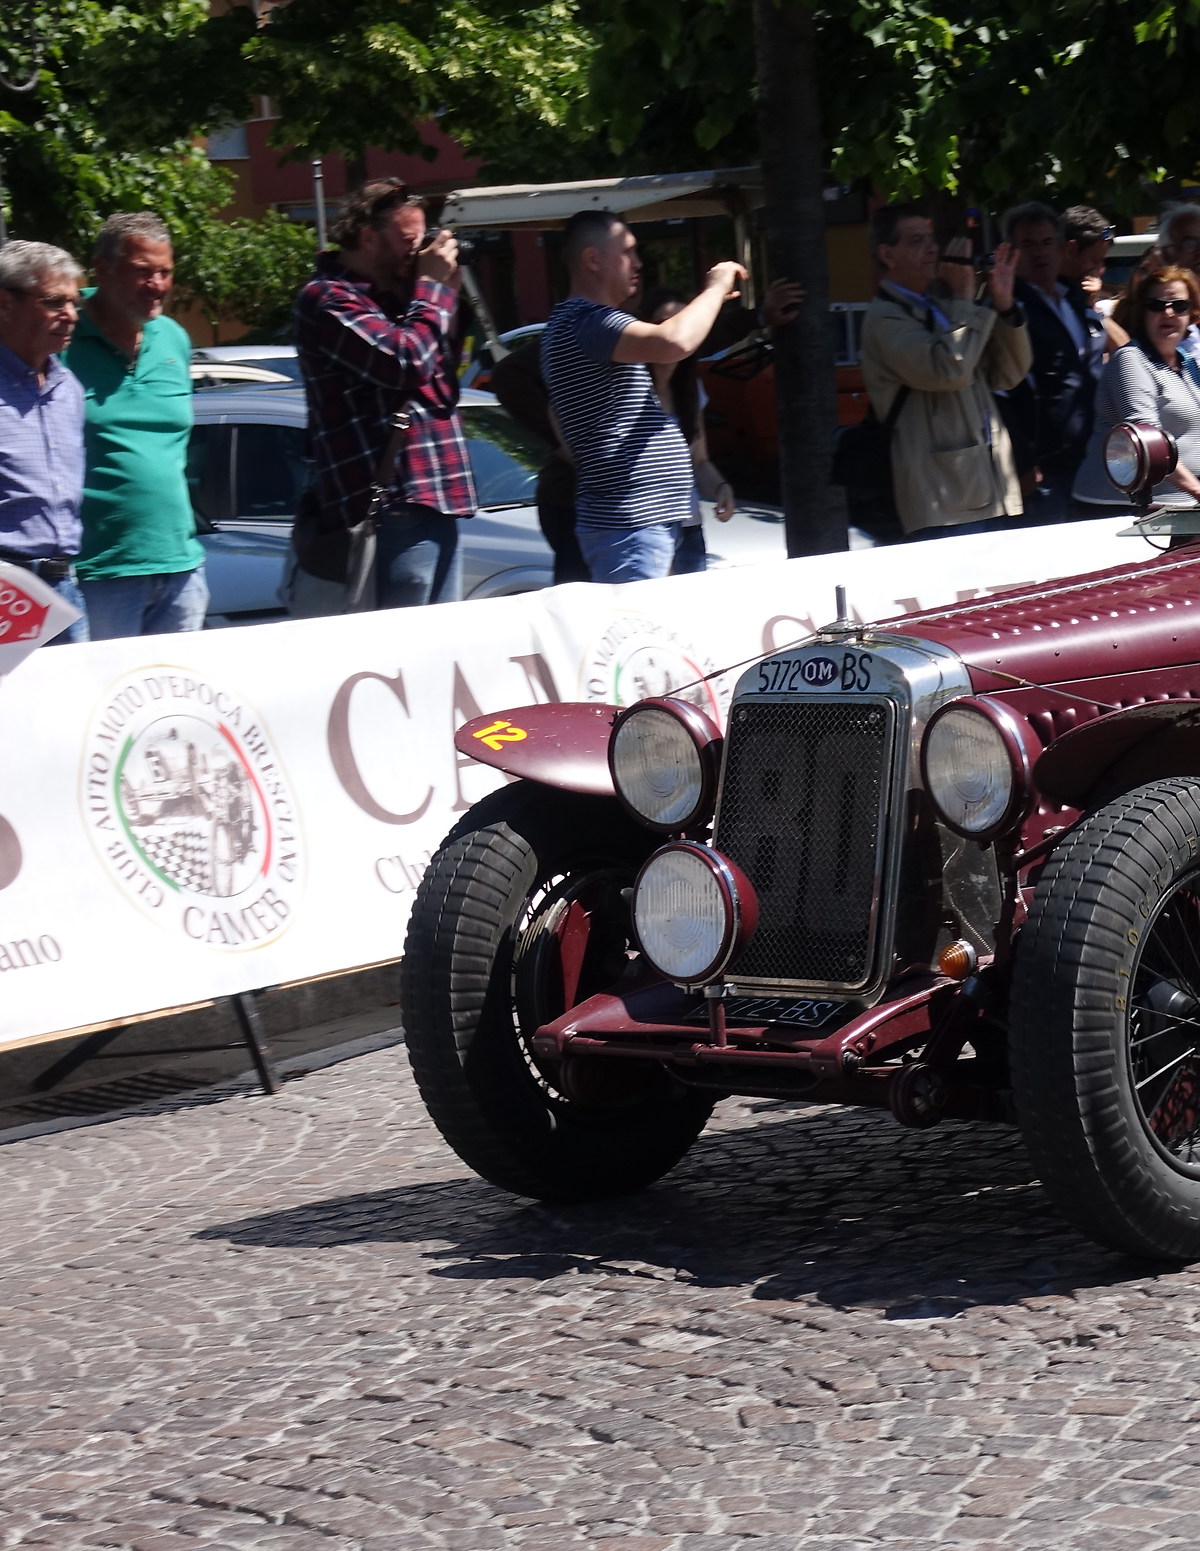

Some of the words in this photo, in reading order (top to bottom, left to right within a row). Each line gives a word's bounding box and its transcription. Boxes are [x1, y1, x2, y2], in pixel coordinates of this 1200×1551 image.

[758, 659, 800, 693] 5772
[803, 657, 834, 682] OM
[841, 653, 873, 691] BS
[96, 685, 144, 749] MOTO
[472, 720, 528, 751] 12
[182, 887, 291, 946] CAMEB
[700, 998, 834, 1022] 772-BS
